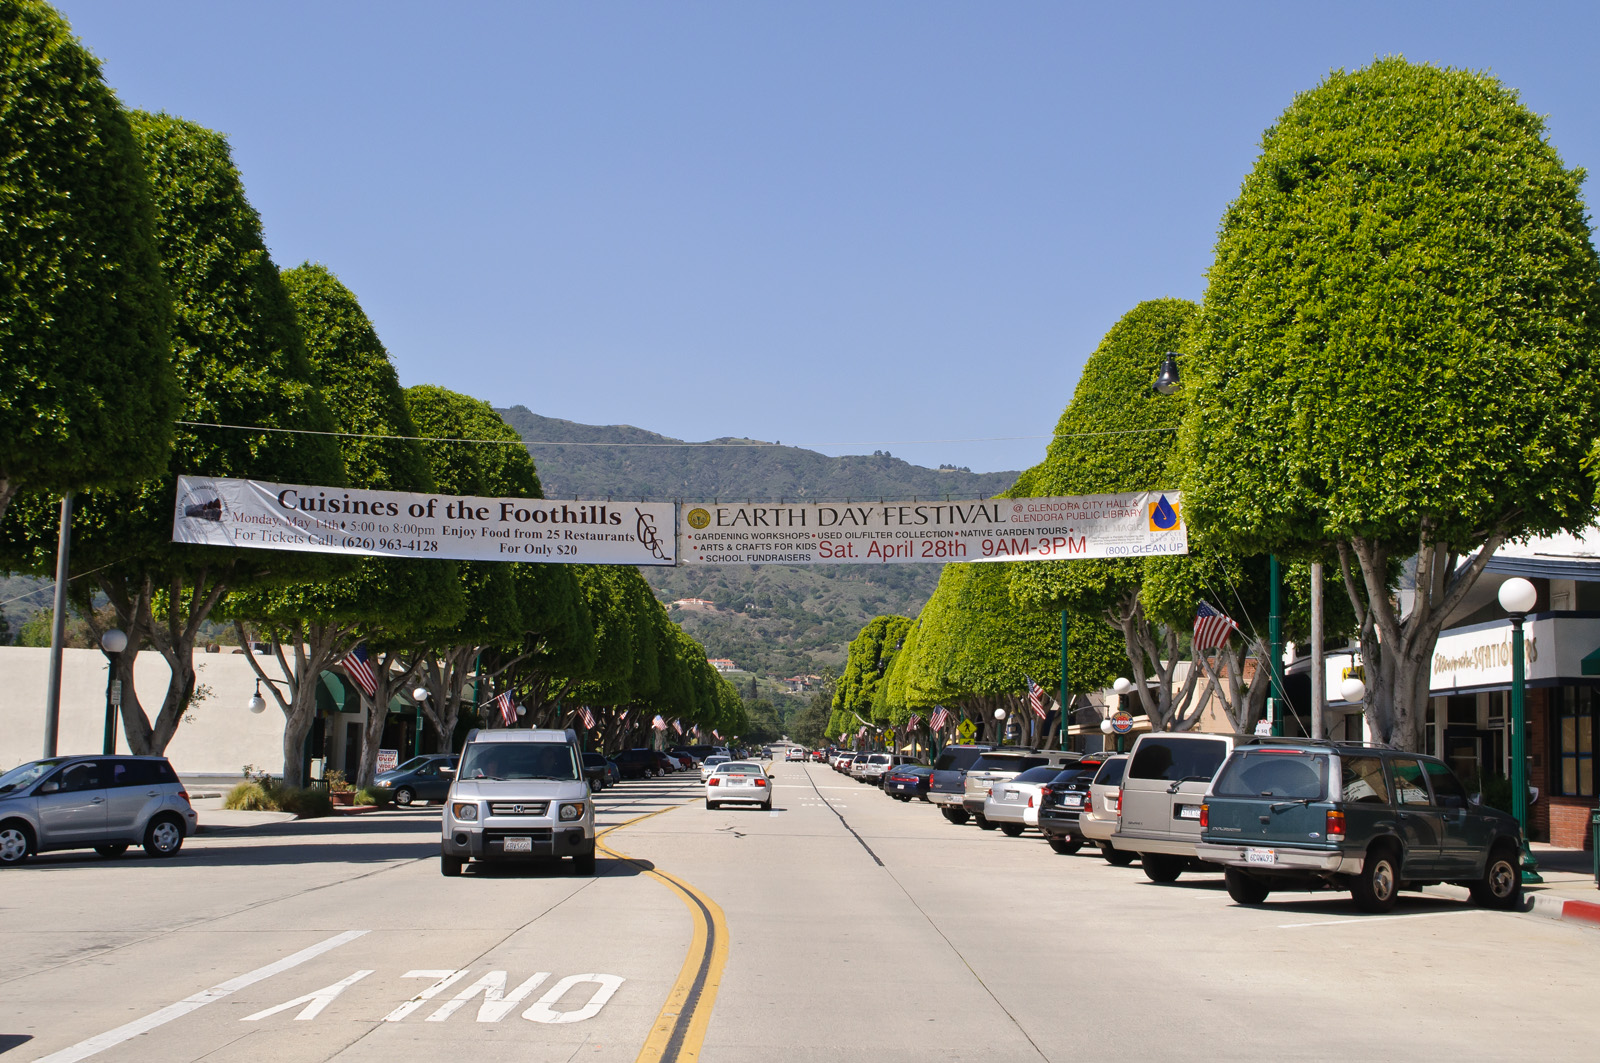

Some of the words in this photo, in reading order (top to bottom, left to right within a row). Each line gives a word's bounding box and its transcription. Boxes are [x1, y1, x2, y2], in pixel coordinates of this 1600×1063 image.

[278, 489, 399, 517] Cuisines
[408, 497, 438, 519] of
[446, 500, 489, 521] the
[499, 502, 622, 525] Foothills
[1013, 503, 1023, 513] @
[1027, 502, 1080, 513] GLENDORA
[1082, 501, 1105, 511] CITY
[1107, 499, 1131, 510] HALL
[1132, 498, 1139, 507] &
[717, 508, 807, 527] EARTH
[818, 507, 874, 526] DAY
[884, 504, 1007, 526] FESTIVAL
[1011, 513, 1064, 523] GLENDORA
[1067, 511, 1101, 521] PUBLIC
[1102, 509, 1143, 519] LIBRARY
[285, 516, 310, 530] May
[315, 518, 339, 531] 14th
[350, 521, 375, 533] 5:00
[378, 523, 389, 534] to
[393, 523, 435, 537] 8:00pm
[442, 525, 477, 539] Enjoy
[482, 526, 510, 538] Food
[514, 527, 543, 539] from
[546, 528, 561, 540] 25
[564, 528, 635, 542] Restaurants
[960, 529, 994, 538] NATIVE
[995, 527, 1035, 537] GARDEN
[1036, 526, 1068, 536] TOURS
[234, 528, 256, 541] For
[260, 529, 304, 545] Tickets
[308, 533, 338, 547] Call:
[342, 535, 375, 550] (626)
[379, 537, 439, 552] 963-4128
[694, 532, 749, 541] GARDENING
[750, 531, 811, 540] WORKSHOPS
[817, 531, 843, 540] USED
[844, 531, 894, 540] OIL/FILTER
[895, 530, 954, 540] COLLECTION
[500, 542, 521, 554] For
[524, 543, 554, 557] Only
[557, 544, 578, 556] $20
[700, 543, 725, 551] ARTS
[727, 543, 733, 551] &
[735, 543, 772, 551] CRAFTS
[774, 542, 793, 551] FOR
[795, 542, 817, 550] KIDS
[818, 540, 859, 558] Sat.
[867, 540, 913, 562] April
[921, 538, 967, 559] 28th
[982, 536, 1087, 557] 9AM-3PM
[1105, 545, 1130, 555] (800)
[1132, 543, 1169, 554] CLEAN
[1171, 542, 1184, 552] UP
[706, 554, 745, 562] SCHOOL
[746, 553, 811, 562] FUNDRAISERS
[240, 970, 625, 1024] ONLY
